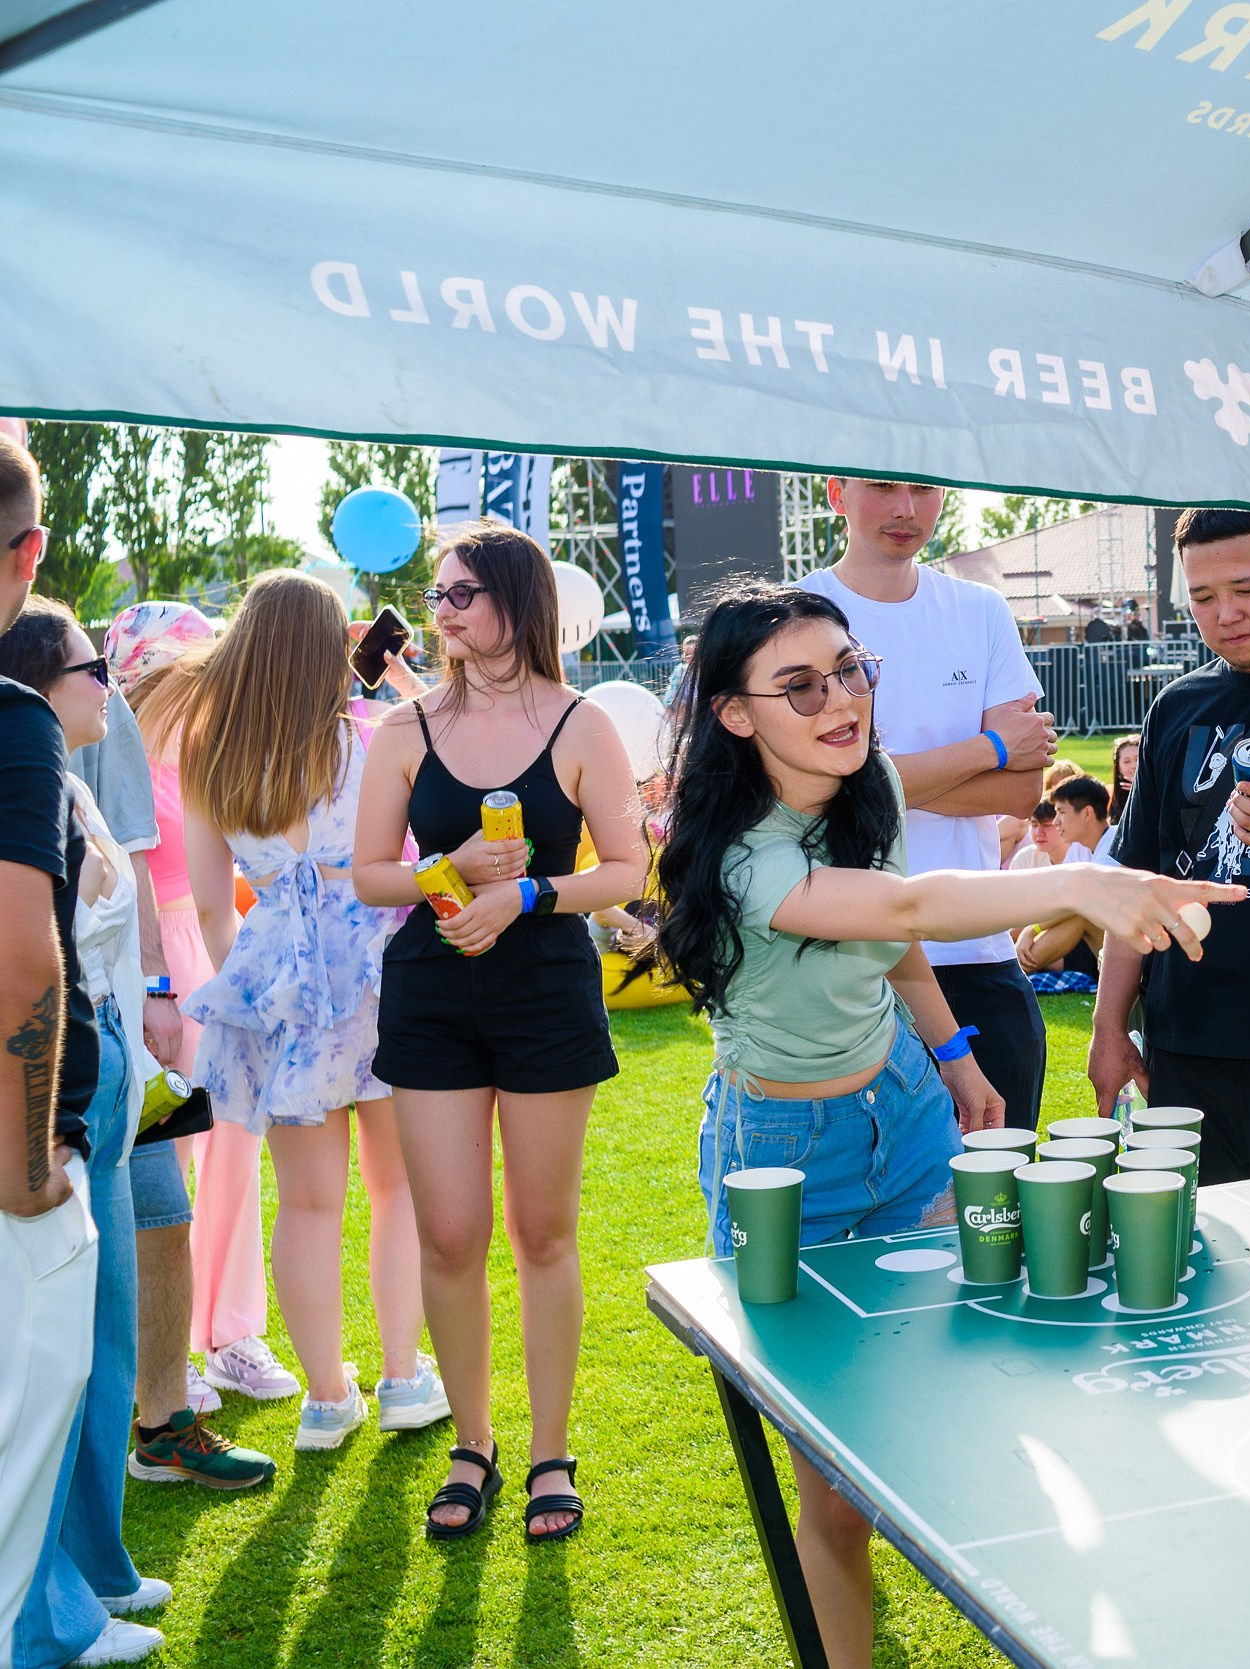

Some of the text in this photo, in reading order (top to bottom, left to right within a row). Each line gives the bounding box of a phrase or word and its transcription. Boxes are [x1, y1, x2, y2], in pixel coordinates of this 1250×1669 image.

[692, 469, 756, 505] ELLE
[621, 472, 652, 633] Partners
[964, 1202, 1022, 1233] Carlsber
[978, 1231, 1020, 1243] DENMARK
